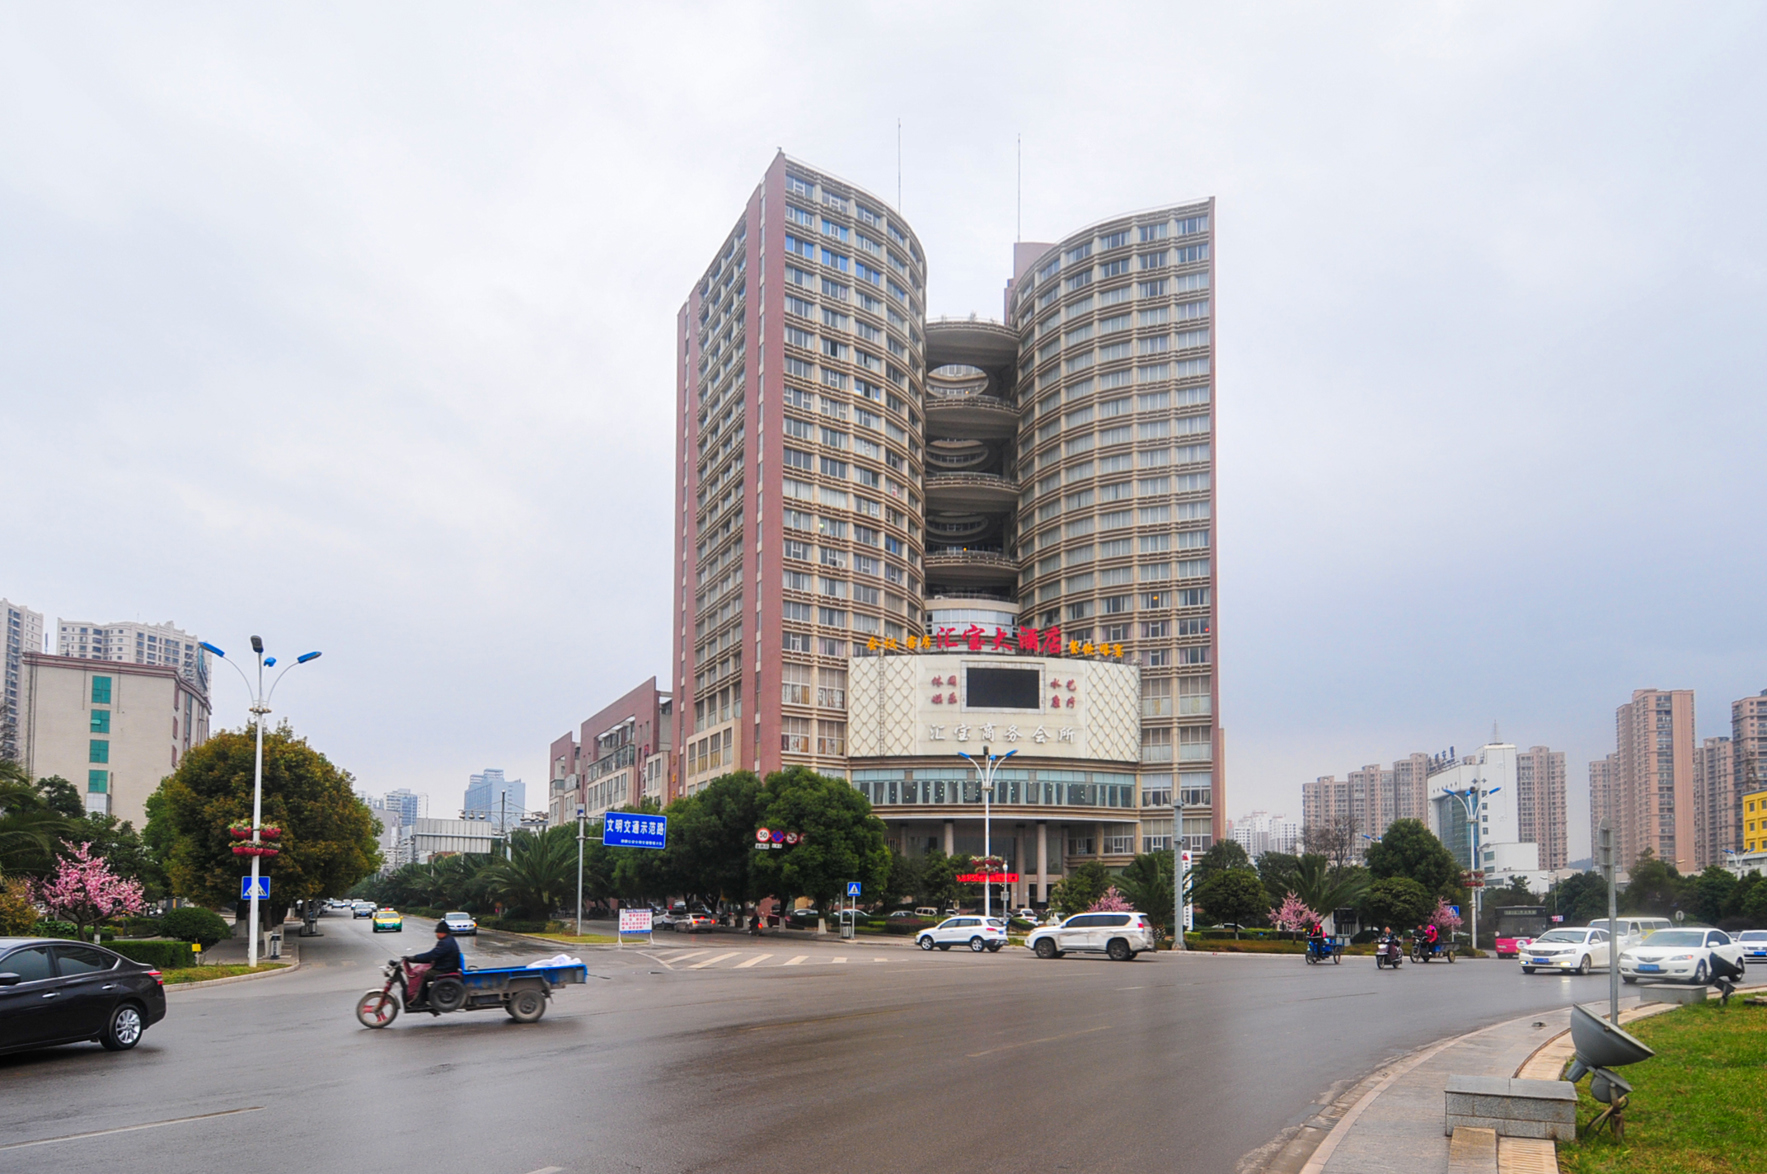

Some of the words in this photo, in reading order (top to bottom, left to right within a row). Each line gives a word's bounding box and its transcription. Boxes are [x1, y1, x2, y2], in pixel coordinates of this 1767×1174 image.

[936, 624, 1062, 654] 汇宝大酒店
[929, 721, 1076, 744] 汇宝商务会所
[606, 818, 665, 836] 文明交通示范路
[759, 831, 768, 839] 50
